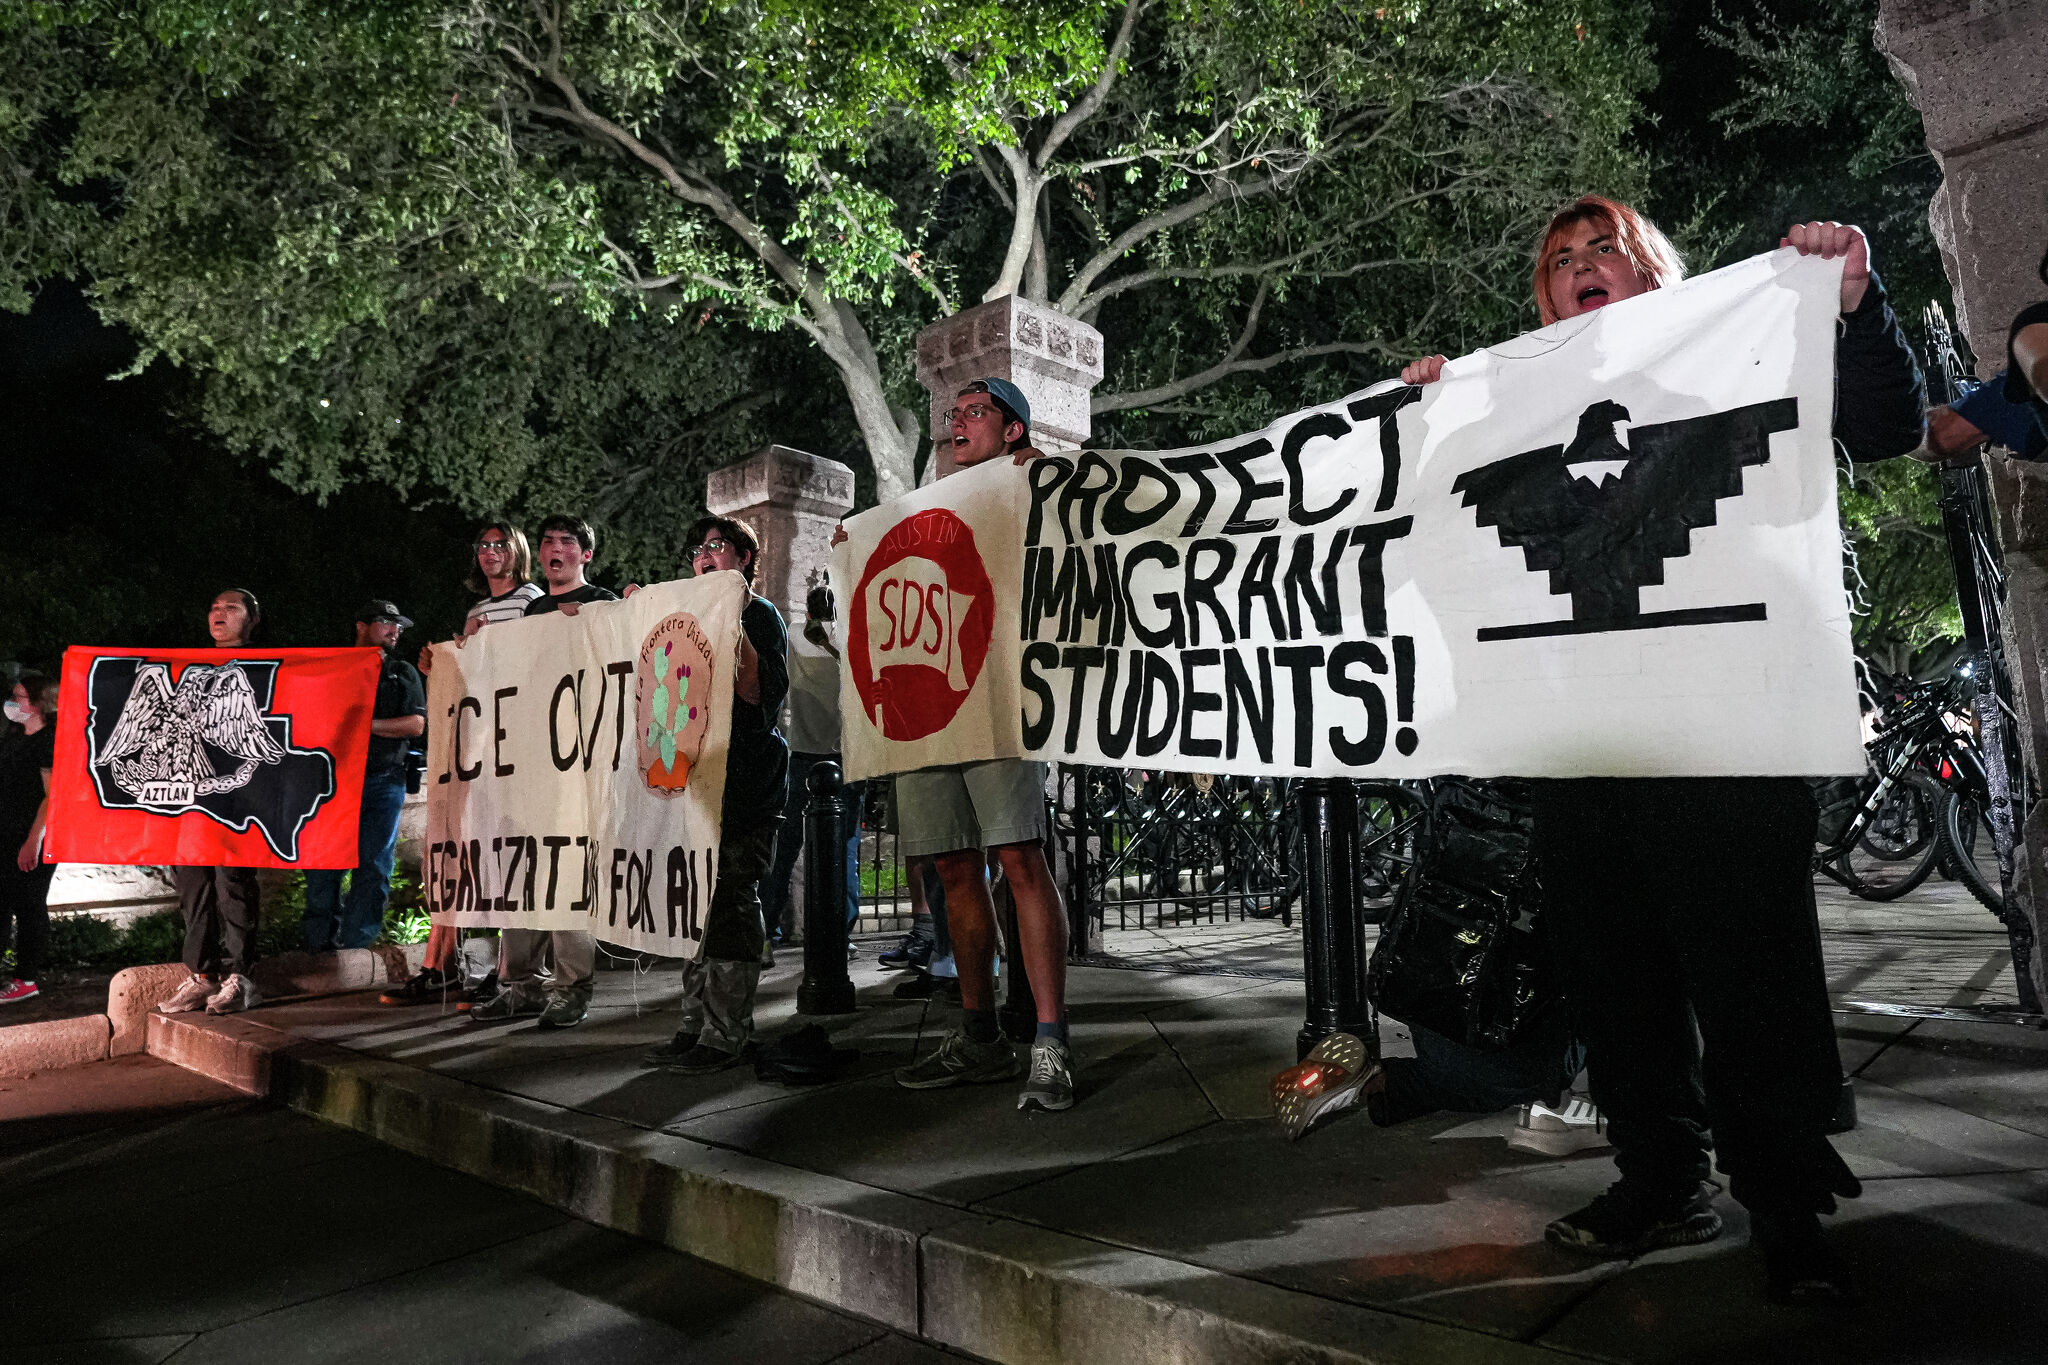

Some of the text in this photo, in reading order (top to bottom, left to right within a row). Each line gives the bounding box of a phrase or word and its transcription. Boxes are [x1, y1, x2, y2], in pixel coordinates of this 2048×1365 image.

[1024, 387, 1423, 547] PROTECT
[884, 513, 960, 560] AUSTIN
[879, 577, 945, 655] SDS
[1020, 514, 1414, 650] IMMIGRANT
[641, 618, 684, 664] Frontera
[438, 686, 519, 785] ICE
[1020, 634, 1419, 769] STUDENTS!
[144, 787, 189, 801] AZTLAN
[609, 848, 656, 934] FOR
